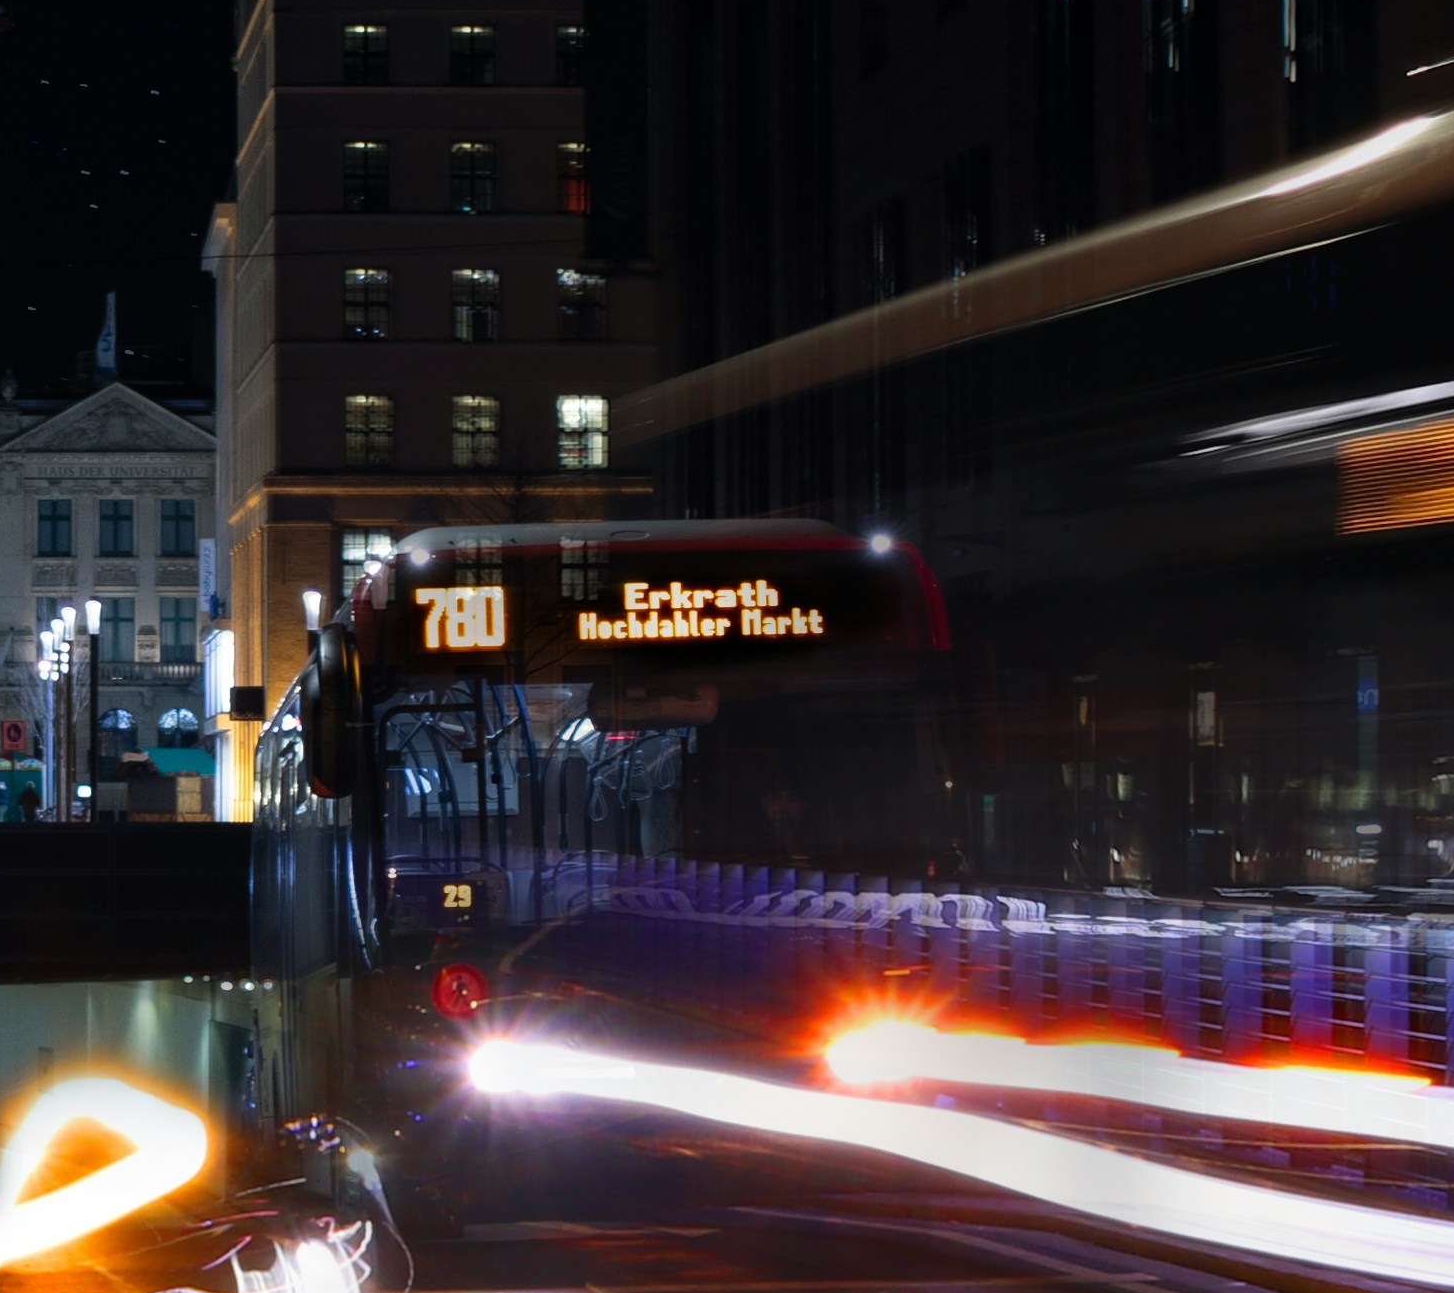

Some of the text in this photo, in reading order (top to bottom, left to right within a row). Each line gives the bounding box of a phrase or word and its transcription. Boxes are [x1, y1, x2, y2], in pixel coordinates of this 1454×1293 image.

[37, 465, 196, 477] HAUS DER UNIVERSITÄT
[624, 579, 780, 610] Erkrath
[415, 586, 506, 648] 780
[578, 607, 824, 640] Hochdahler Markt
[443, 885, 472, 908] 29
